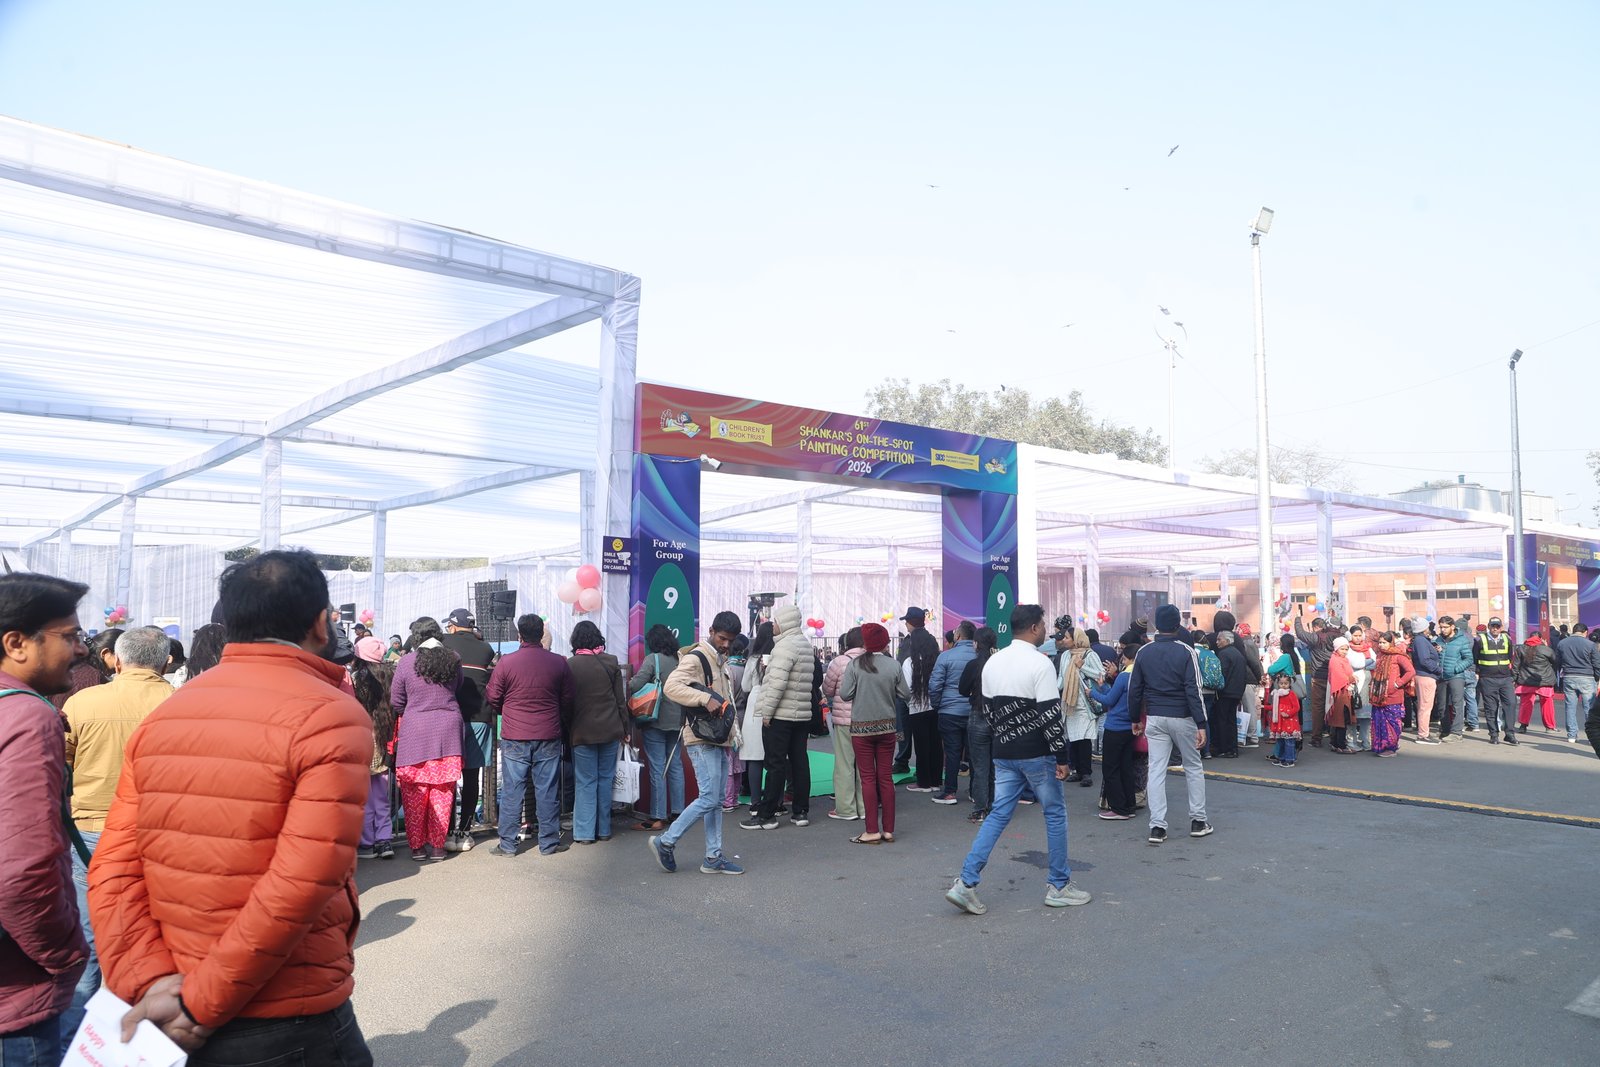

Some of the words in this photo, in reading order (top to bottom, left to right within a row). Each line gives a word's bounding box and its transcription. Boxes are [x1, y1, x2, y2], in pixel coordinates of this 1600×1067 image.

[728, 423, 766, 434] CHILDREN'S
[728, 431, 746, 439] BOOK
[747, 433, 765, 441] TRUST
[799, 425, 853, 443] SHANKAR'S
[856, 434, 914, 451] ON-THE-SPOT
[800, 439, 848, 457] PAINTING
[852, 446, 915, 465] COMPETITION
[847, 460, 872, 474] 2026
[653, 539, 669, 548] For
[670, 540, 687, 550] Age
[655, 550, 684, 562] Group
[990, 554, 1000, 562] For
[1000, 555, 1011, 563] Age
[991, 563, 1009, 573] Group
[663, 586, 679, 609] 9
[997, 591, 1007, 610] 9
[997, 621, 1008, 634] to
